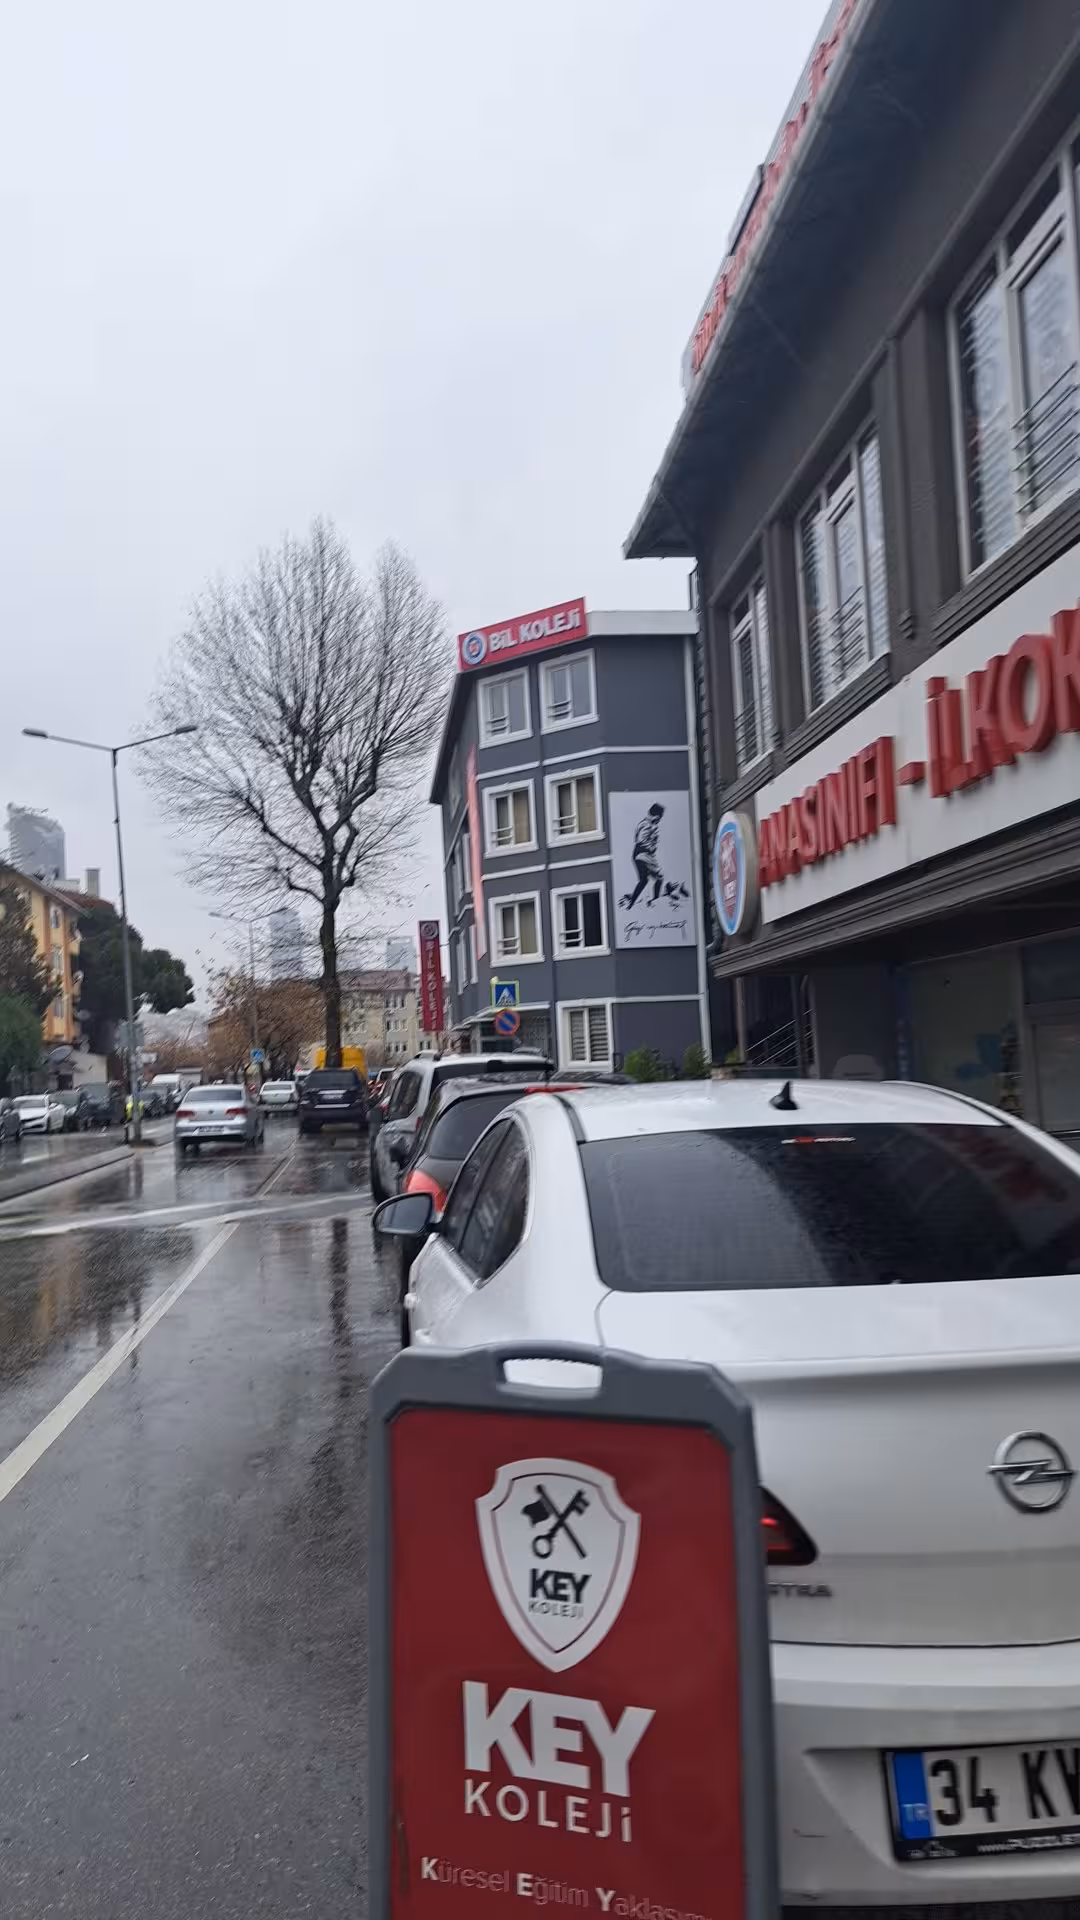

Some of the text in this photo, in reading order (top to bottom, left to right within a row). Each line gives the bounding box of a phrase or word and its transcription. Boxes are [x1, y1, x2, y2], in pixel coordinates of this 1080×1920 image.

[530, 1568, 592, 1604] KEY
[463, 1680, 656, 1797] KEY
[930, 1756, 997, 1826] 34
[421, 1856, 510, 1892] Küresel
[517, 1872, 589, 1907] Eğitim
